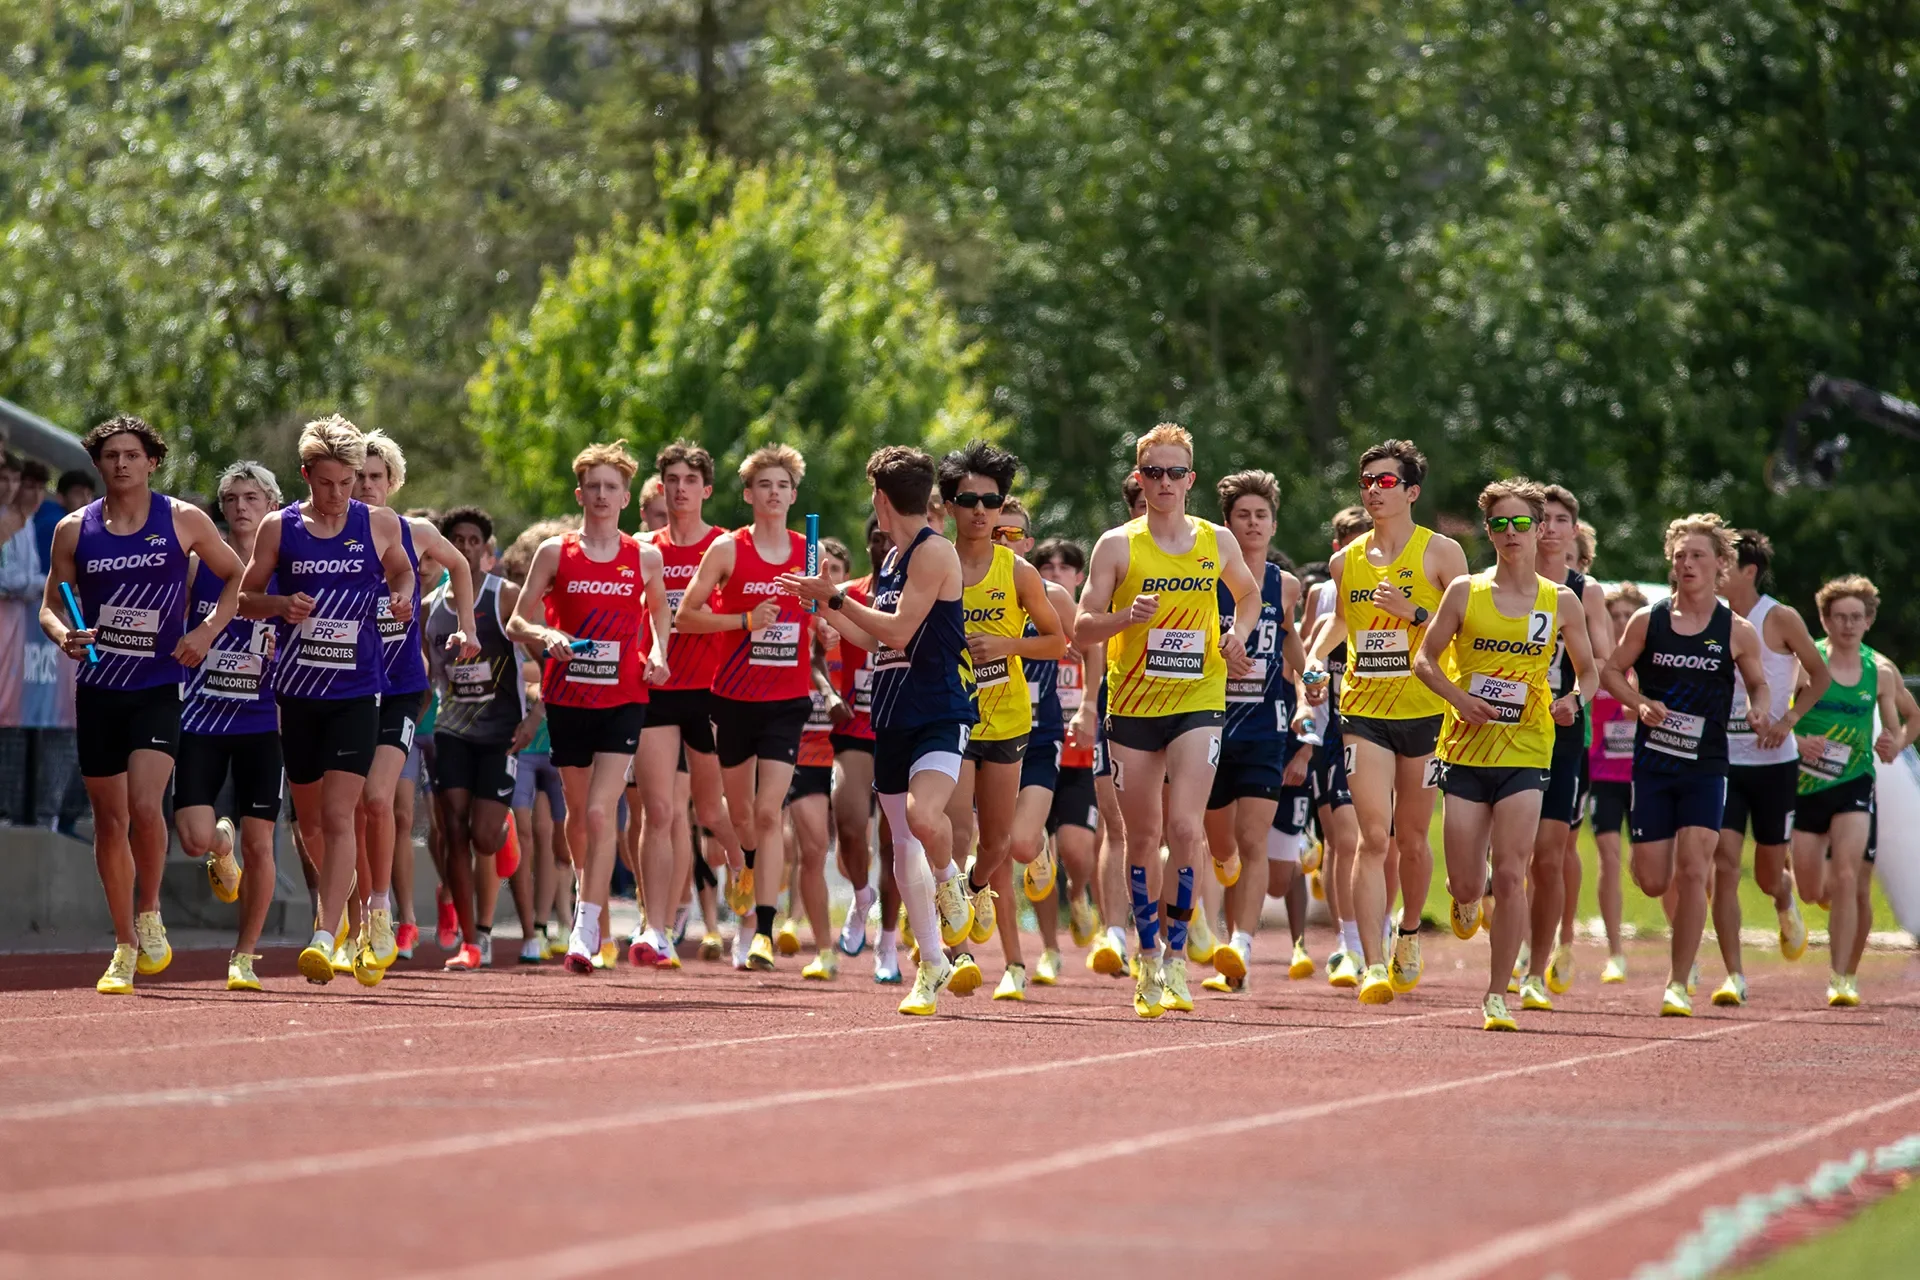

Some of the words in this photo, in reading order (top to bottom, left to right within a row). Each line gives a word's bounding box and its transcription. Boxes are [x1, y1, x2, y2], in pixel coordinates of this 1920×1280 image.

[150, 537, 167, 546] PR
[349, 543, 364, 552] PR
[86, 552, 168, 573] BROOKS
[291, 559, 365, 575] BROOKS
[1202, 561, 1214, 570] PR
[621, 569, 635, 578] PR
[1400, 570, 1413, 578] PR
[567, 580, 634, 597] BROOKS
[1141, 577, 1214, 592] BROOKS
[991, 592, 1006, 601] PR
[115, 608, 148, 618] BROOKS
[111, 615, 134, 628] PR
[316, 620, 349, 629] BROOKS
[311, 627, 335, 640] PR
[1532, 613, 1548, 643] 2
[101, 631, 154, 647] ANACORTES
[259, 626, 269, 653] 1
[763, 630, 783, 641] PR
[1165, 631, 1196, 639] BROOKS
[1262, 625, 1274, 652] 5
[1367, 631, 1396, 639] BROOKS
[1160, 638, 1183, 650] PR
[1365, 639, 1385, 650] PR
[1473, 638, 1546, 656] BROOKS
[1708, 644, 1722, 653] PR
[220, 652, 252, 661] BROOKS
[301, 644, 354, 659] ANACORTES
[216, 659, 238, 671] PR
[1149, 655, 1201, 669] ARLINGTON
[1358, 656, 1407, 667] ARLINGTON
[1652, 652, 1721, 671] BROOKS
[569, 662, 596, 674] CENTRAL
[974, 663, 1006, 679] NGTON
[206, 674, 258, 690] ANACORTES
[1485, 678, 1518, 690] BROOKS
[1480, 685, 1502, 698] PR
[1663, 717, 1682, 730] PR
